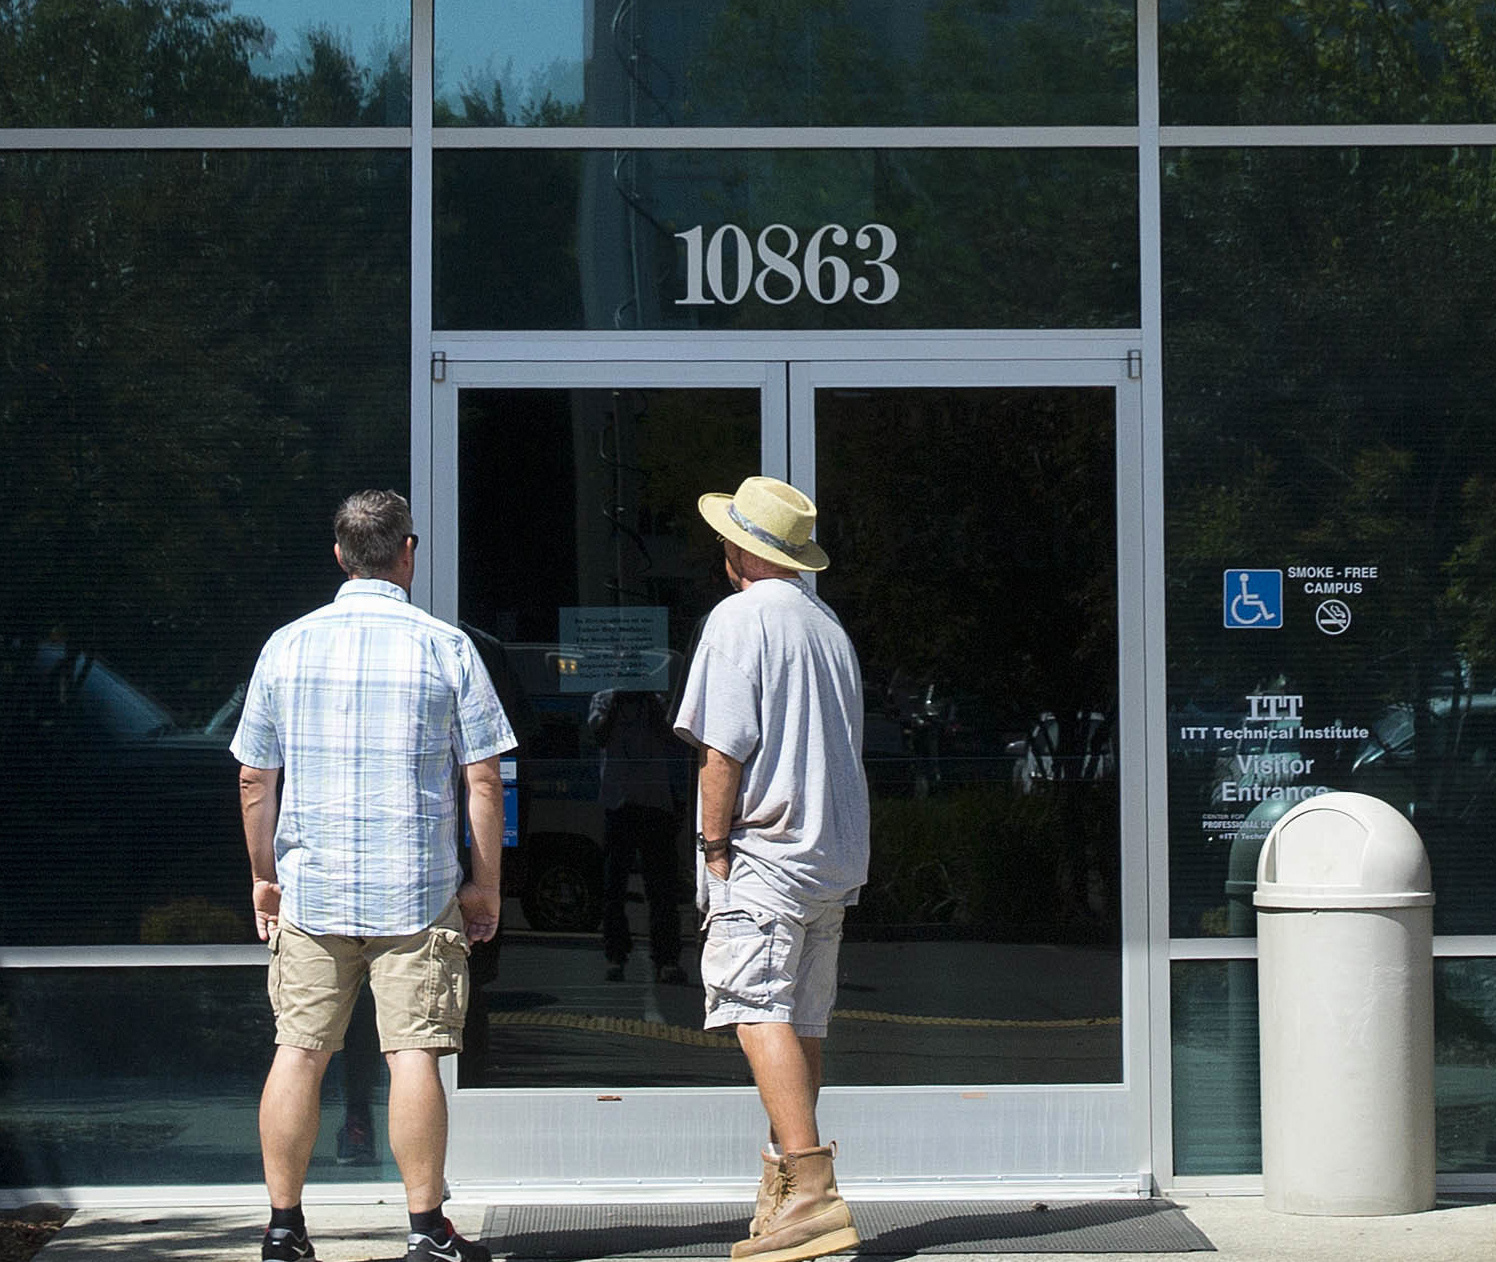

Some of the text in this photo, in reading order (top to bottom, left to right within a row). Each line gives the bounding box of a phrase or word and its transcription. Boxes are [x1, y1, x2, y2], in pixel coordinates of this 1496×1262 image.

[674, 223, 900, 305] 10863
[1287, 566, 1334, 578] SMOKE
[1344, 566, 1378, 578] FREE
[1304, 582, 1363, 594] CAMPUS
[1246, 695, 1303, 720] ITT
[1181, 726, 1370, 739] ITT Technical Institute
[1236, 754, 1315, 775] Visitor
[1221, 781, 1329, 802] Entrance
[1202, 821, 1259, 829] PROFESSIONAL
[1241, 832, 1268, 840] Techni
